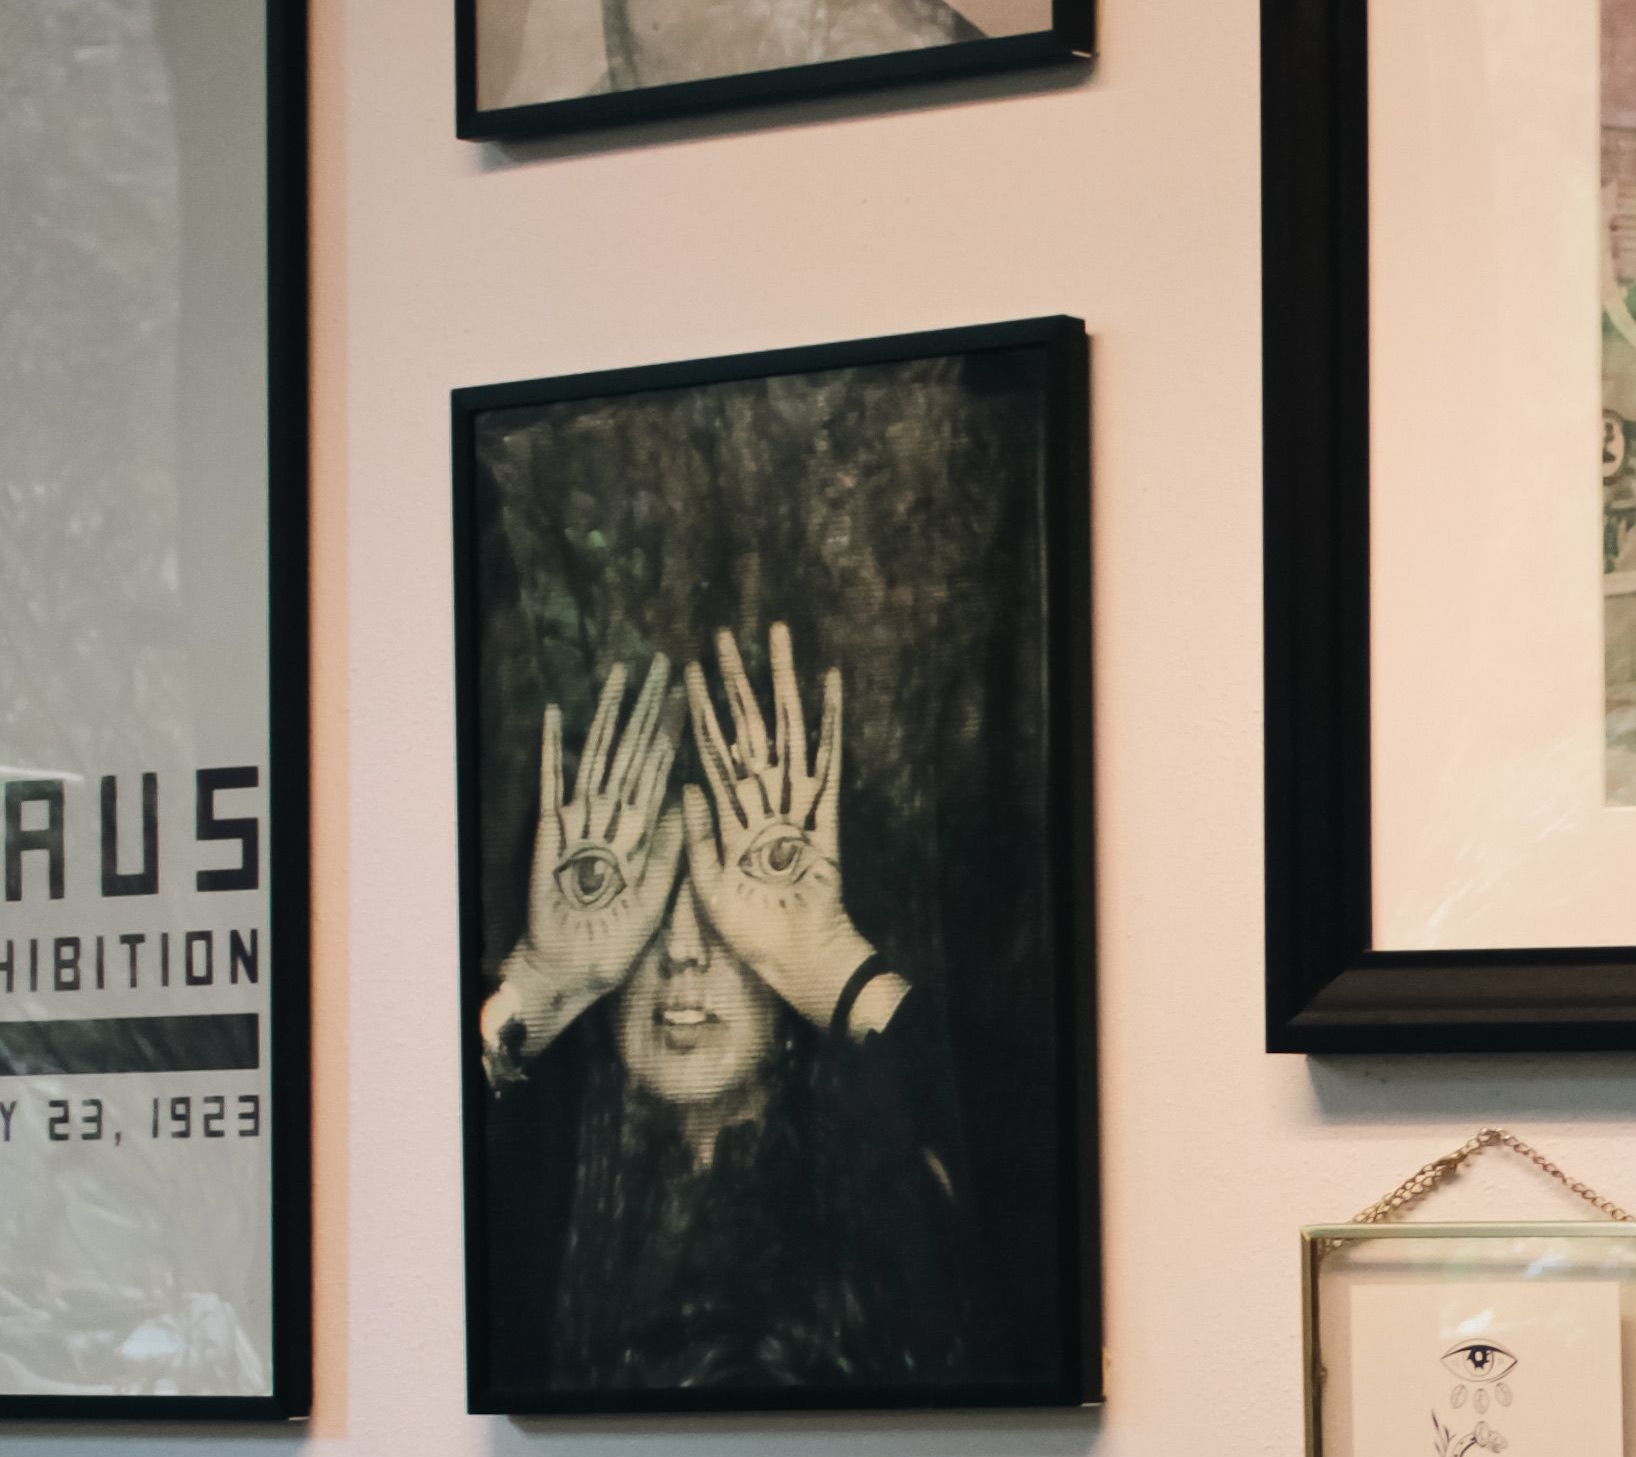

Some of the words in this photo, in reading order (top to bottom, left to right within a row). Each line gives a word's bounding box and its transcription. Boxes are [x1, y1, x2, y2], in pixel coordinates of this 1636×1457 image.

[5, 766, 259, 901] AUS
[48, 1099, 122, 1146] 23,
[152, 1095, 260, 1139] 1923
